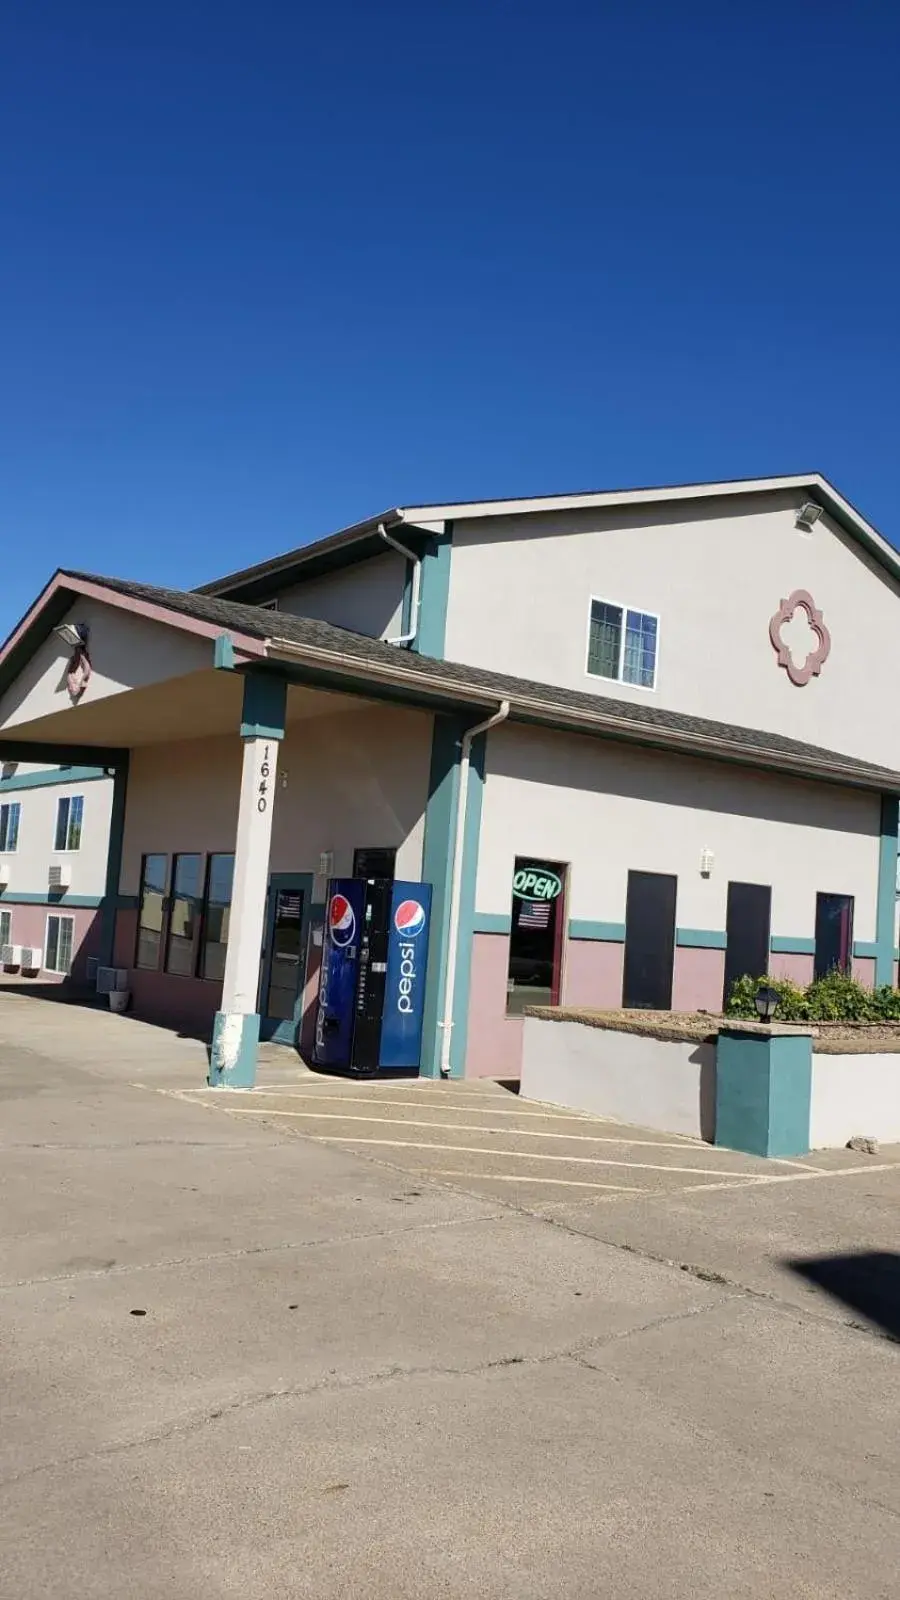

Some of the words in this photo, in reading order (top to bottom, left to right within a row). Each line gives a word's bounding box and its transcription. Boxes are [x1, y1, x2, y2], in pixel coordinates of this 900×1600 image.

[257, 744, 270, 813] 1640
[513, 870, 557, 900] OPEN
[316, 964, 329, 1047] pepsi
[398, 942, 417, 1014] pepsi
